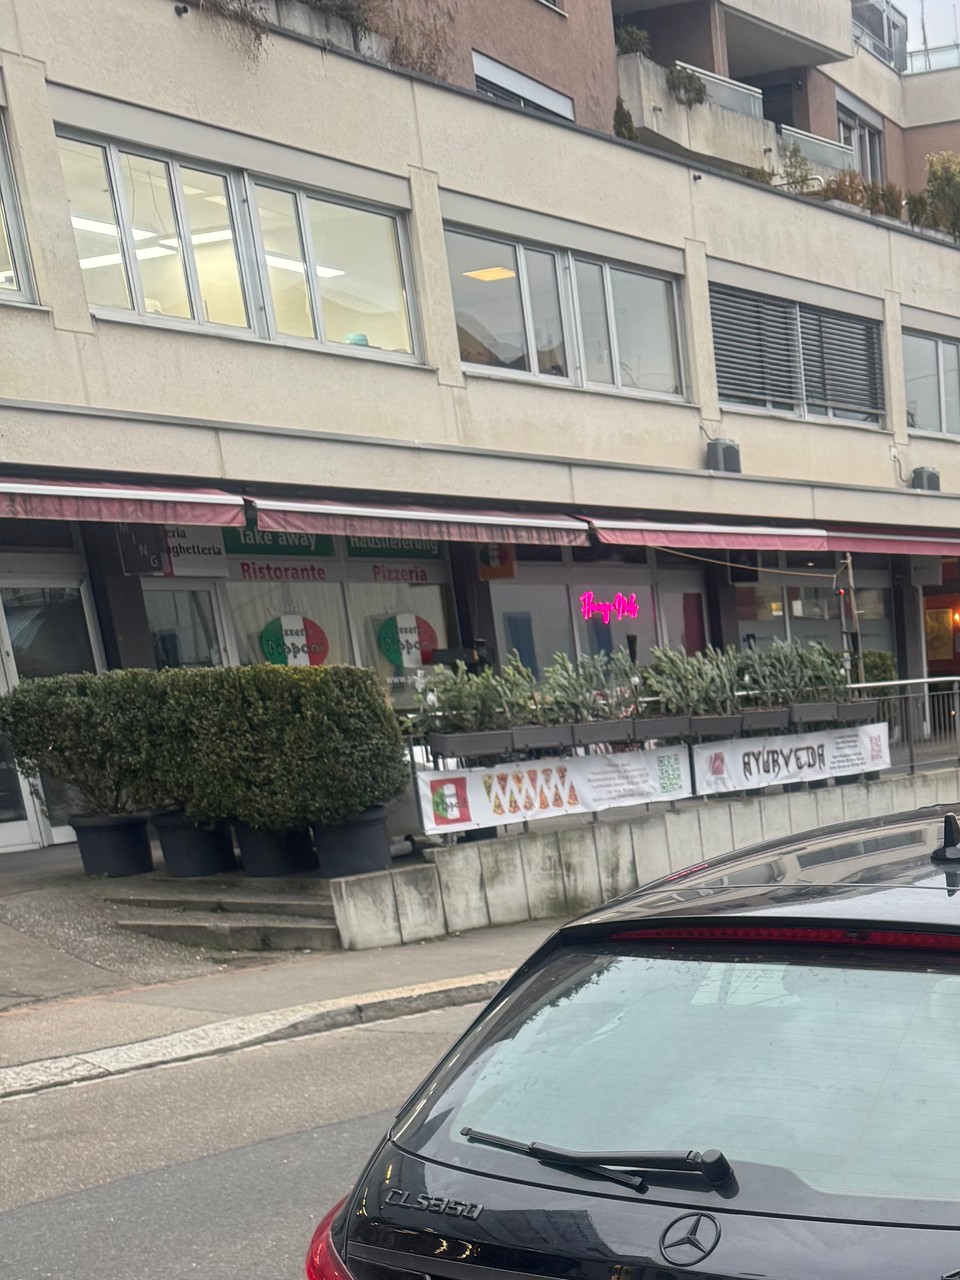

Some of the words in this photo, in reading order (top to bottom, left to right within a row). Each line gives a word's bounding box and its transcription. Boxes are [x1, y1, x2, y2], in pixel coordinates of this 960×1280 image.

[165, 527, 187, 539] eria
[237, 528, 273, 545] Take
[279, 531, 317, 550] away
[240, 562, 326, 581] Ristorante
[372, 564, 429, 582] Pizzeria
[743, 745, 825, 781] AYURVEDA
